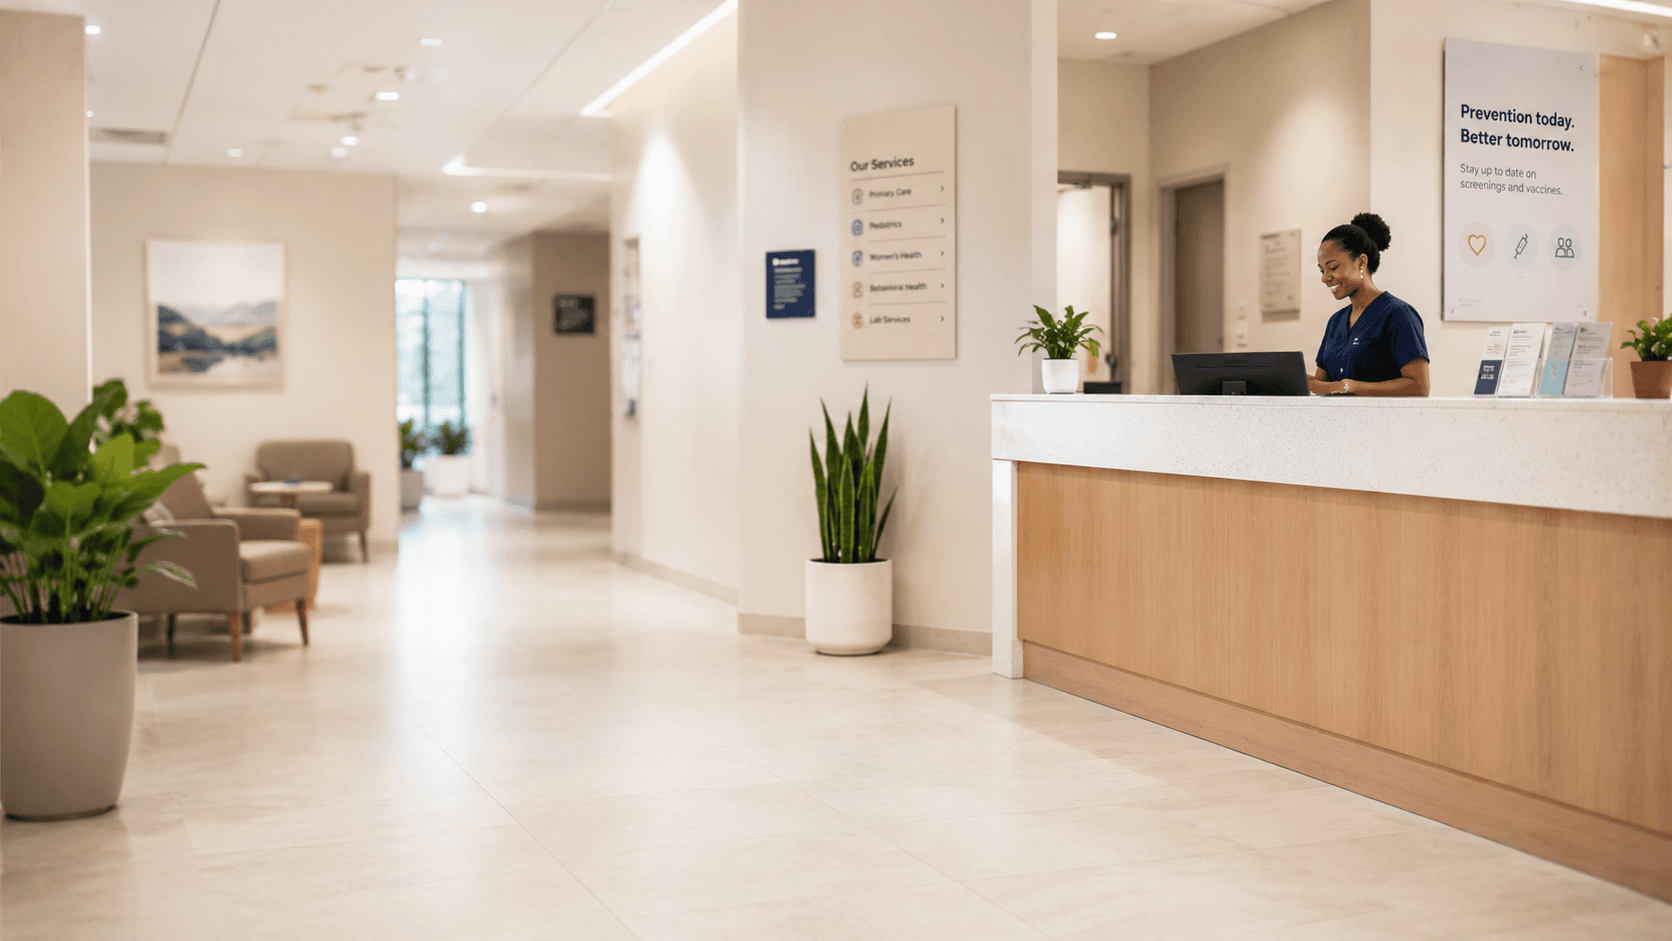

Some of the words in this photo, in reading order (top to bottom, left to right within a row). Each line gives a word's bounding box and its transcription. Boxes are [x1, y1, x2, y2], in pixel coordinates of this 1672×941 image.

[1461, 104, 1532, 124] Prevention
[1535, 112, 1575, 131] today.
[1461, 128, 1503, 146] Better
[1506, 133, 1574, 152] tomorrow.
[850, 161, 869, 172] Our
[871, 156, 915, 170] Services
[1460, 163, 1480, 176] Stay
[1481, 167, 1492, 176] up
[1494, 167, 1503, 176] to
[1505, 167, 1524, 178] date
[1525, 170, 1536, 179] on
[869, 190, 895, 198] Primary
[896, 188, 912, 196] Care
[1460, 180, 1506, 193] screenings
[1508, 183, 1524, 193] and
[1526, 184, 1563, 195] vaccines.
[869, 221, 902, 229] Pediatrics
[869, 252, 899, 260] Women's
[900, 250, 922, 259] Health
[870, 284, 904, 292] Behavioral
[870, 316, 882, 324] Lab
[884, 315, 911, 324] Services
